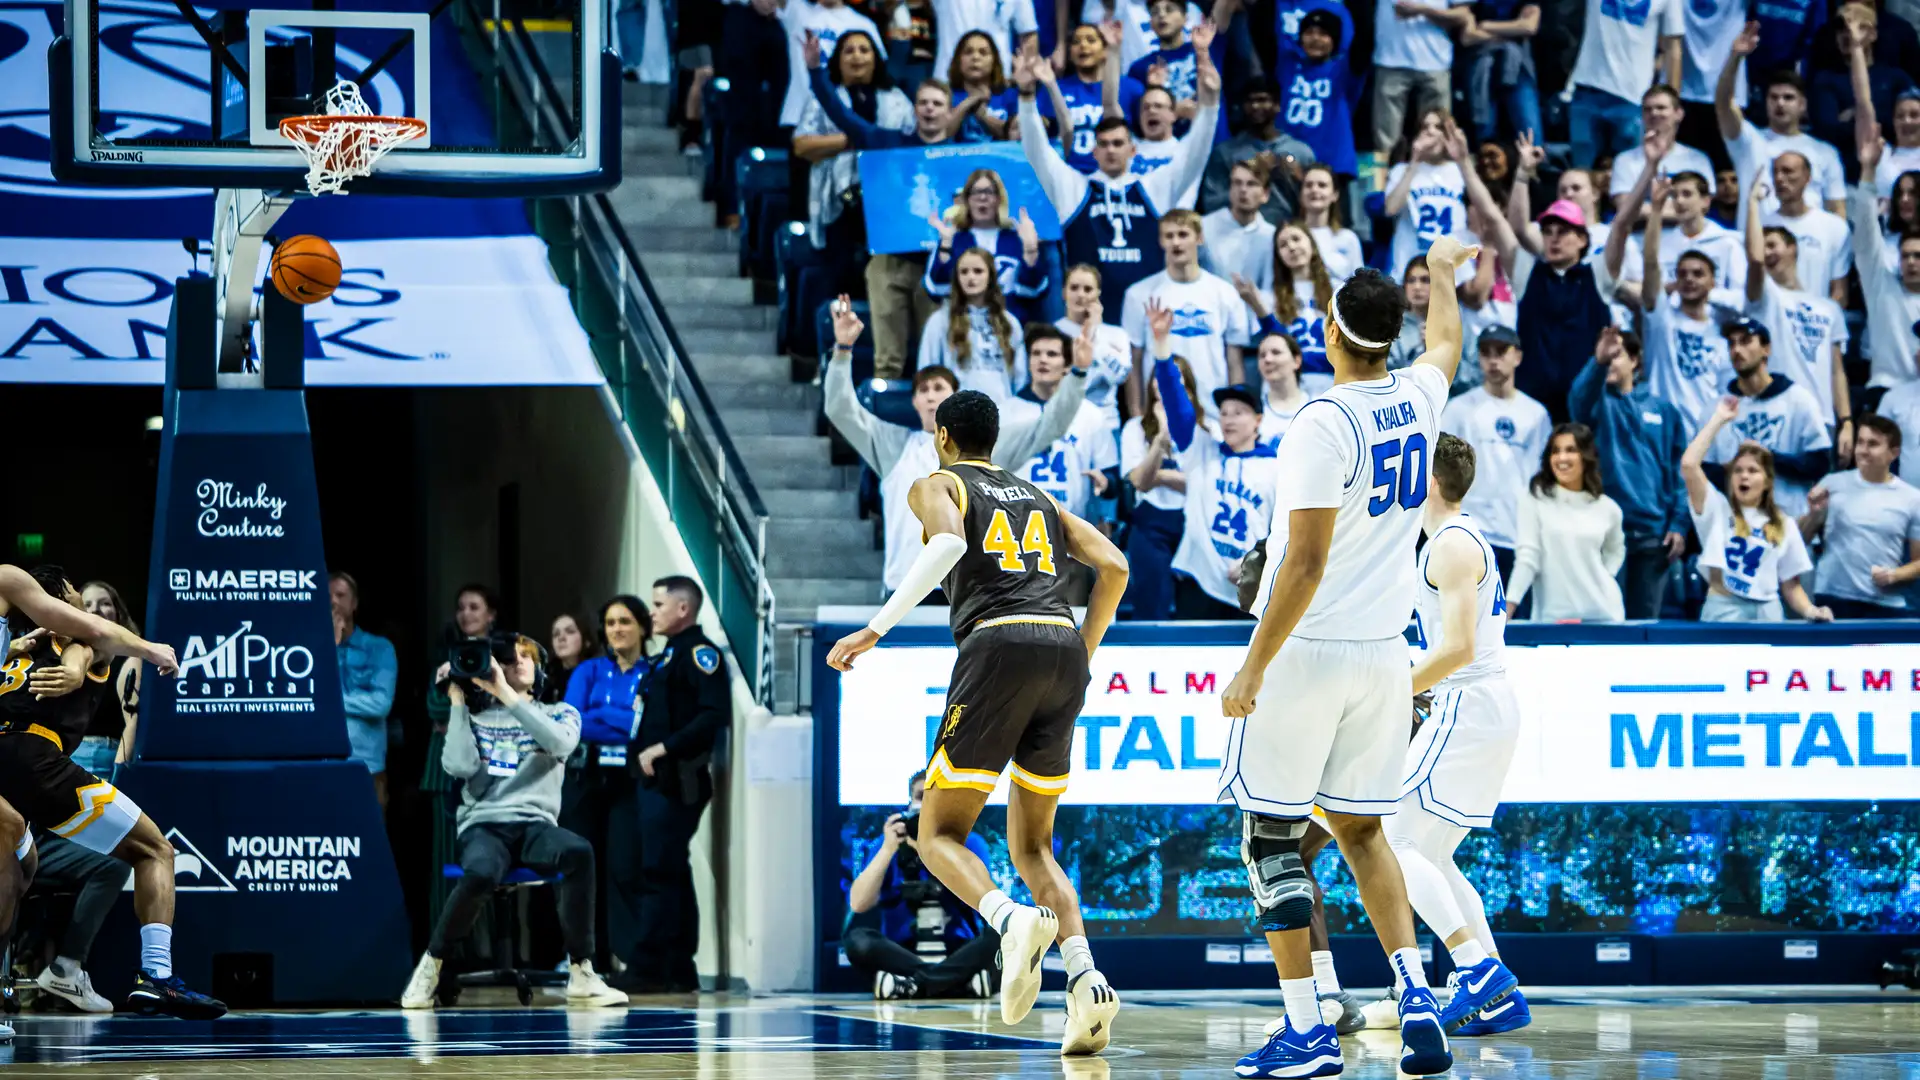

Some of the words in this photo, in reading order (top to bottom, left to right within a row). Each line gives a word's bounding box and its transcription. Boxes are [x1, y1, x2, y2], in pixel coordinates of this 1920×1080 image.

[91, 151, 143, 163] SPALDING
[1418, 204, 1453, 235] 24
[0, 265, 402, 308] IOS
[1372, 400, 1417, 433] KHALIFA
[1030, 446, 1068, 483] 24
[1367, 432, 1427, 517] 50
[196, 479, 287, 520] Minky
[198, 508, 285, 537] Couture
[1211, 501, 1248, 542] 24
[982, 508, 1057, 577] 44
[1725, 535, 1765, 578] 24
[195, 569, 318, 590] MAERSK
[176, 591, 217, 601] FULFILL
[226, 591, 260, 601] STORE
[268, 591, 312, 601] DELIVER
[176, 678, 315, 697] Capital
[1105, 671, 1240, 694] ALM
[176, 703, 202, 713] REAL
[205, 703, 241, 713] ESTATE
[244, 703, 315, 713] INVESTMENTS
[227, 836, 361, 857] MOUNTAIN
[234, 859, 352, 880] AMERICA
[248, 882, 295, 892] CREDIT
[299, 882, 338, 892] UNION
